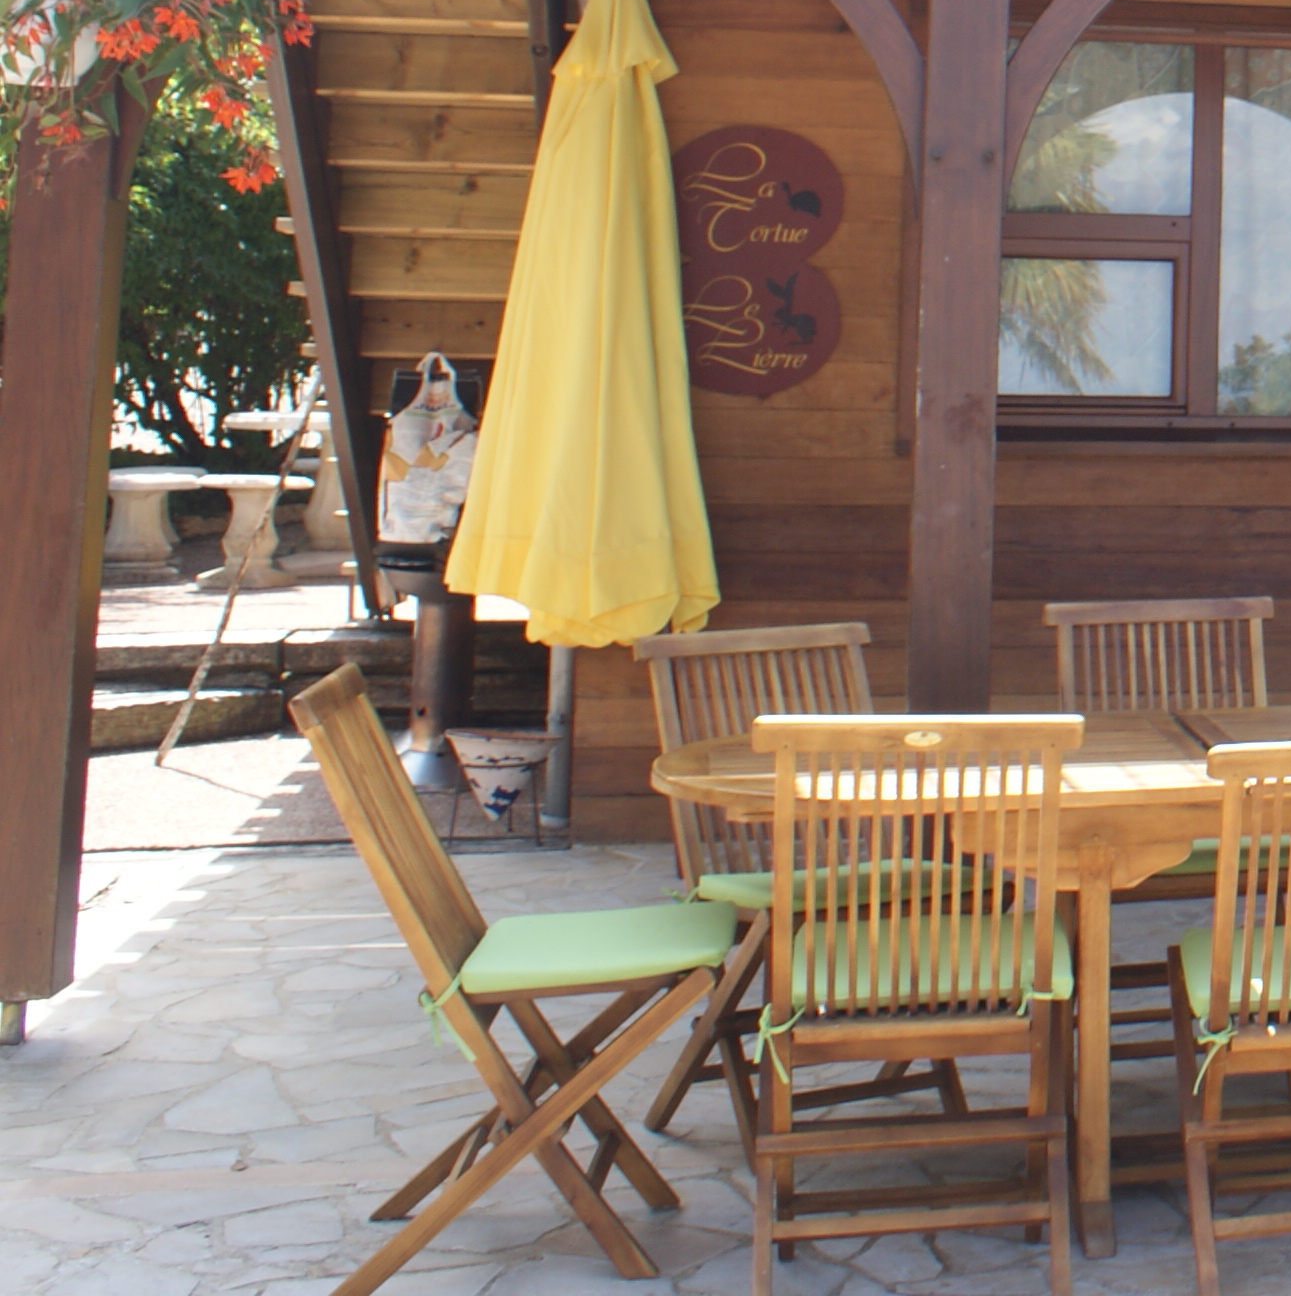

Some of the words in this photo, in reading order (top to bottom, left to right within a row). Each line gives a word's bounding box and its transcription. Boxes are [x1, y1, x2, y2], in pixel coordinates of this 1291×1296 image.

[681, 142, 777, 206] La
[697, 200, 810, 253] Tortue
[682, 275, 760, 336] Le
